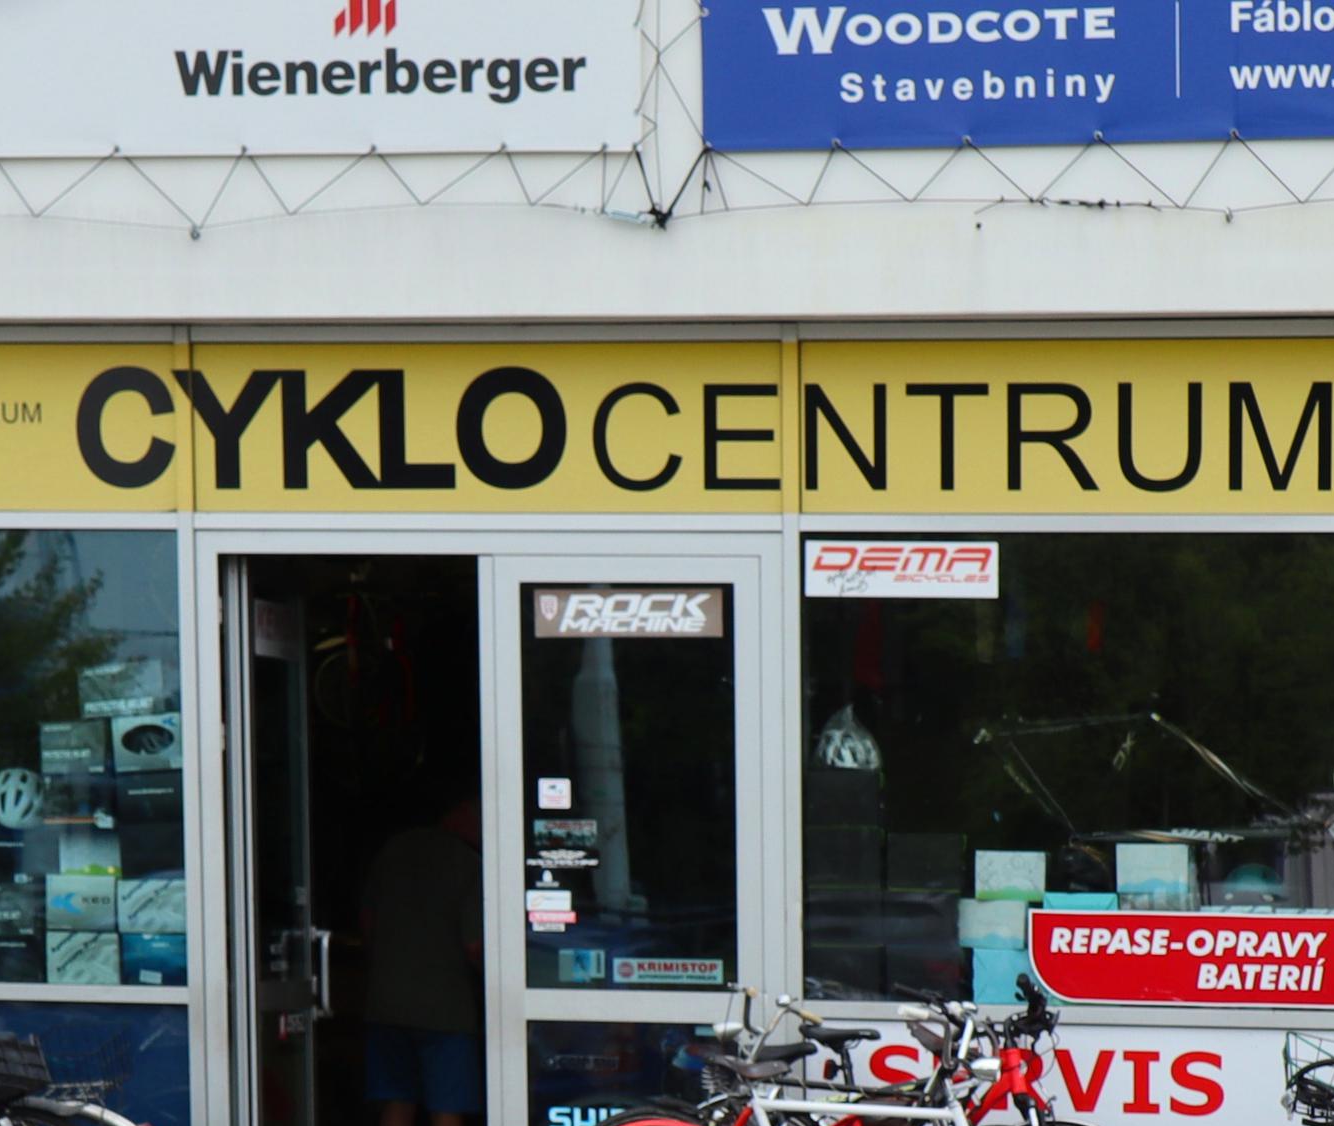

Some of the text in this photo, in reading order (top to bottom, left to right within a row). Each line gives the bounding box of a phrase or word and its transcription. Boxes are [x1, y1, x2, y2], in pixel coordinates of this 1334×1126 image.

[174, 48, 586, 104] Wienerberger
[839, 69, 1116, 103] Stavebniny
[75, 365, 1334, 492] CYKLOCENTRUM
[812, 546, 993, 572] DEMA
[565, 593, 712, 618] ROCK
[559, 616, 707, 633] MACHINE
[1050, 926, 1328, 960] REPASE-OPRAVY
[636, 962, 718, 974] KRIMISTOP
[1197, 957, 1326, 993] BATERIÍ
[869, 1044, 1227, 1117] SRVIS
